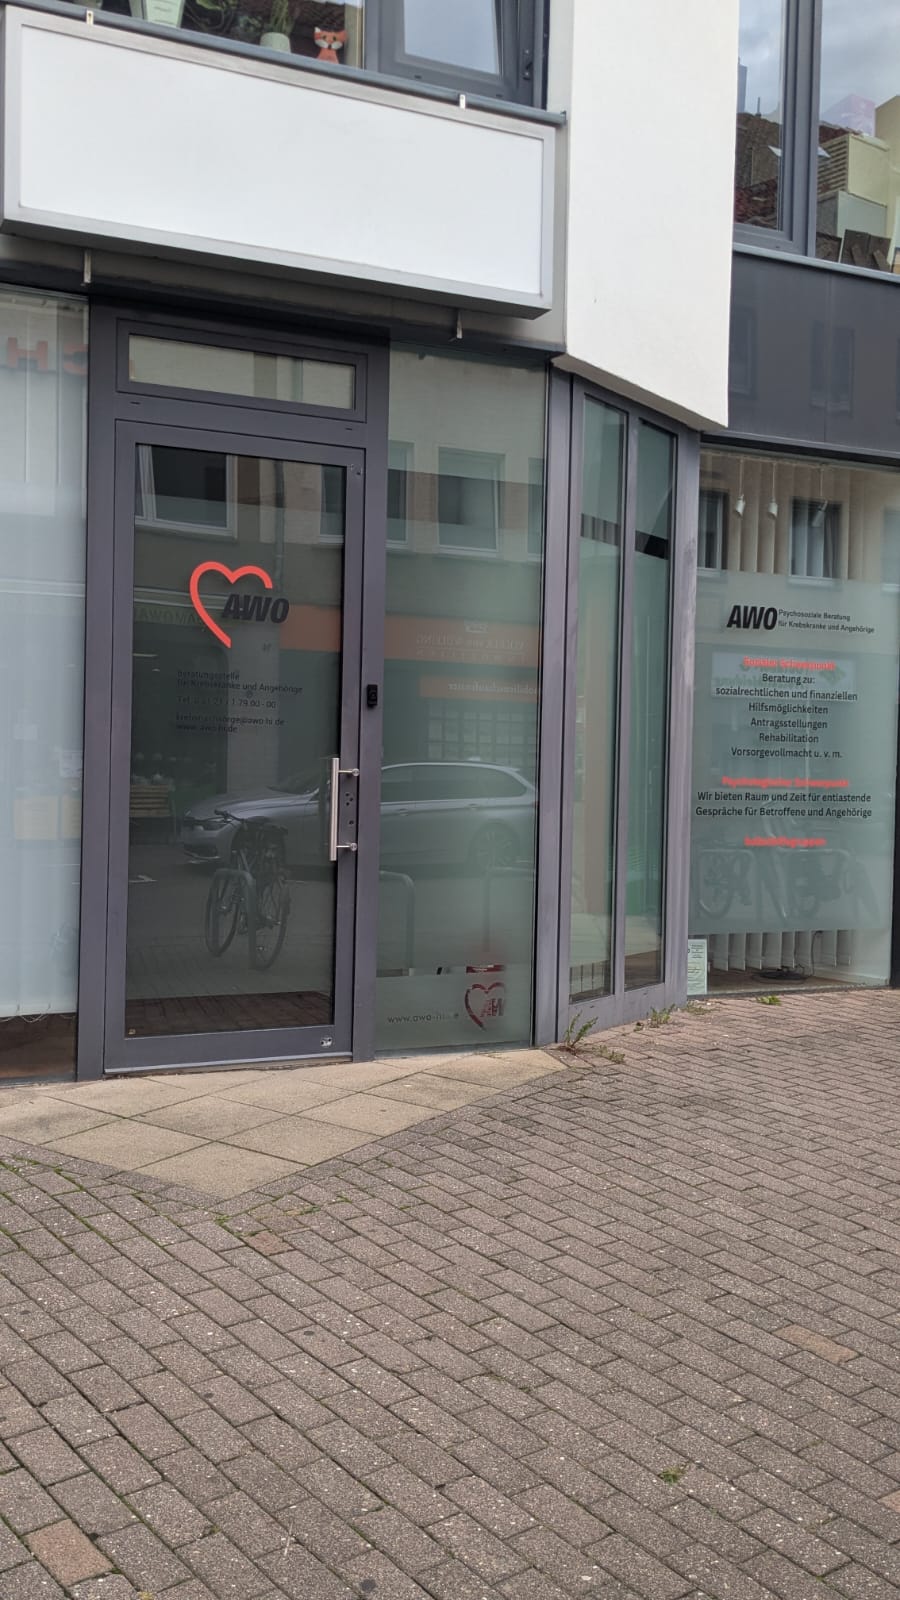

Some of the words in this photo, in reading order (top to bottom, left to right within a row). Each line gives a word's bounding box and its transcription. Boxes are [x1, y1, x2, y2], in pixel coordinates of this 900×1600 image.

[220, 593, 290, 624] AWO
[726, 604, 778, 630] AWO
[778, 609, 822, 620] Psychosoziale
[824, 612, 851, 622] Beratung
[778, 620, 788, 628] für
[788, 621, 826, 630] Krebskranke
[828, 623, 840, 631] und
[840, 624, 875, 634] Angehörige
[762, 673, 801, 686] Beratung
[803, 676, 816, 684] zu:
[242, 682, 257, 691] und
[259, 683, 303, 695] Angehörige
[715, 687, 790, 699] sozialrechtlichen
[791, 690, 808, 699] und
[809, 691, 858, 701] finanziellen
[748, 702, 829, 715] Hilfsmöglichkeiten
[750, 717, 828, 730] Antragsstellungen
[759, 732, 819, 743] Rehabilitation
[731, 747, 812, 759] Vorsorgevollmacht
[697, 791, 712, 801] Wir
[715, 791, 743, 801] bieten
[745, 792, 770, 801] Raum
[771, 792, 788, 802] und
[789, 792, 806, 802] Zeit
[807, 792, 821, 802] für
[822, 793, 872, 803] entlastende
[695, 806, 743, 818] Gespräche
[744, 807, 757, 816] für
[759, 807, 806, 817] Betroffene
[807, 807, 824, 817] und
[825, 807, 872, 819] Angehörige
